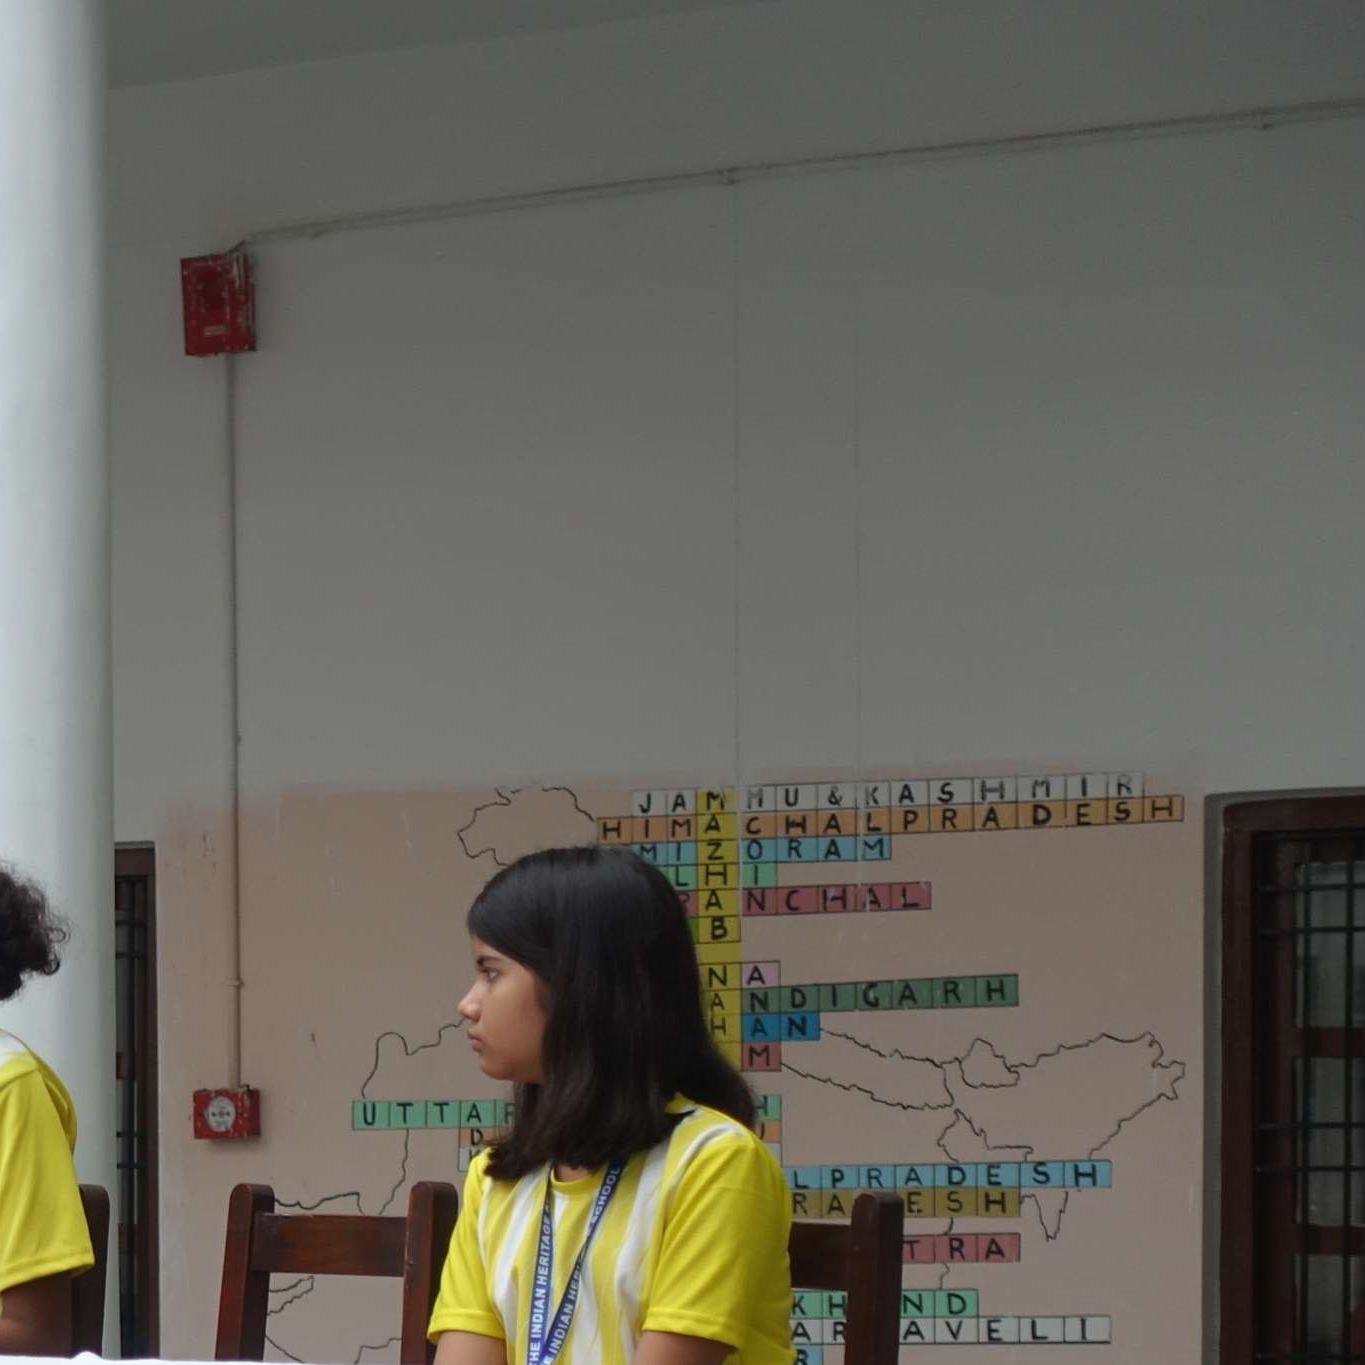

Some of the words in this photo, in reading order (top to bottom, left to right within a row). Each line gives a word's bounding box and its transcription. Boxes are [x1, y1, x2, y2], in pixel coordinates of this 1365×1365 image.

[536, 1214, 552, 1287] HERITAGE
[531, 1287, 547, 1339] INDIAN
[548, 1304, 573, 1357] INDIAN
